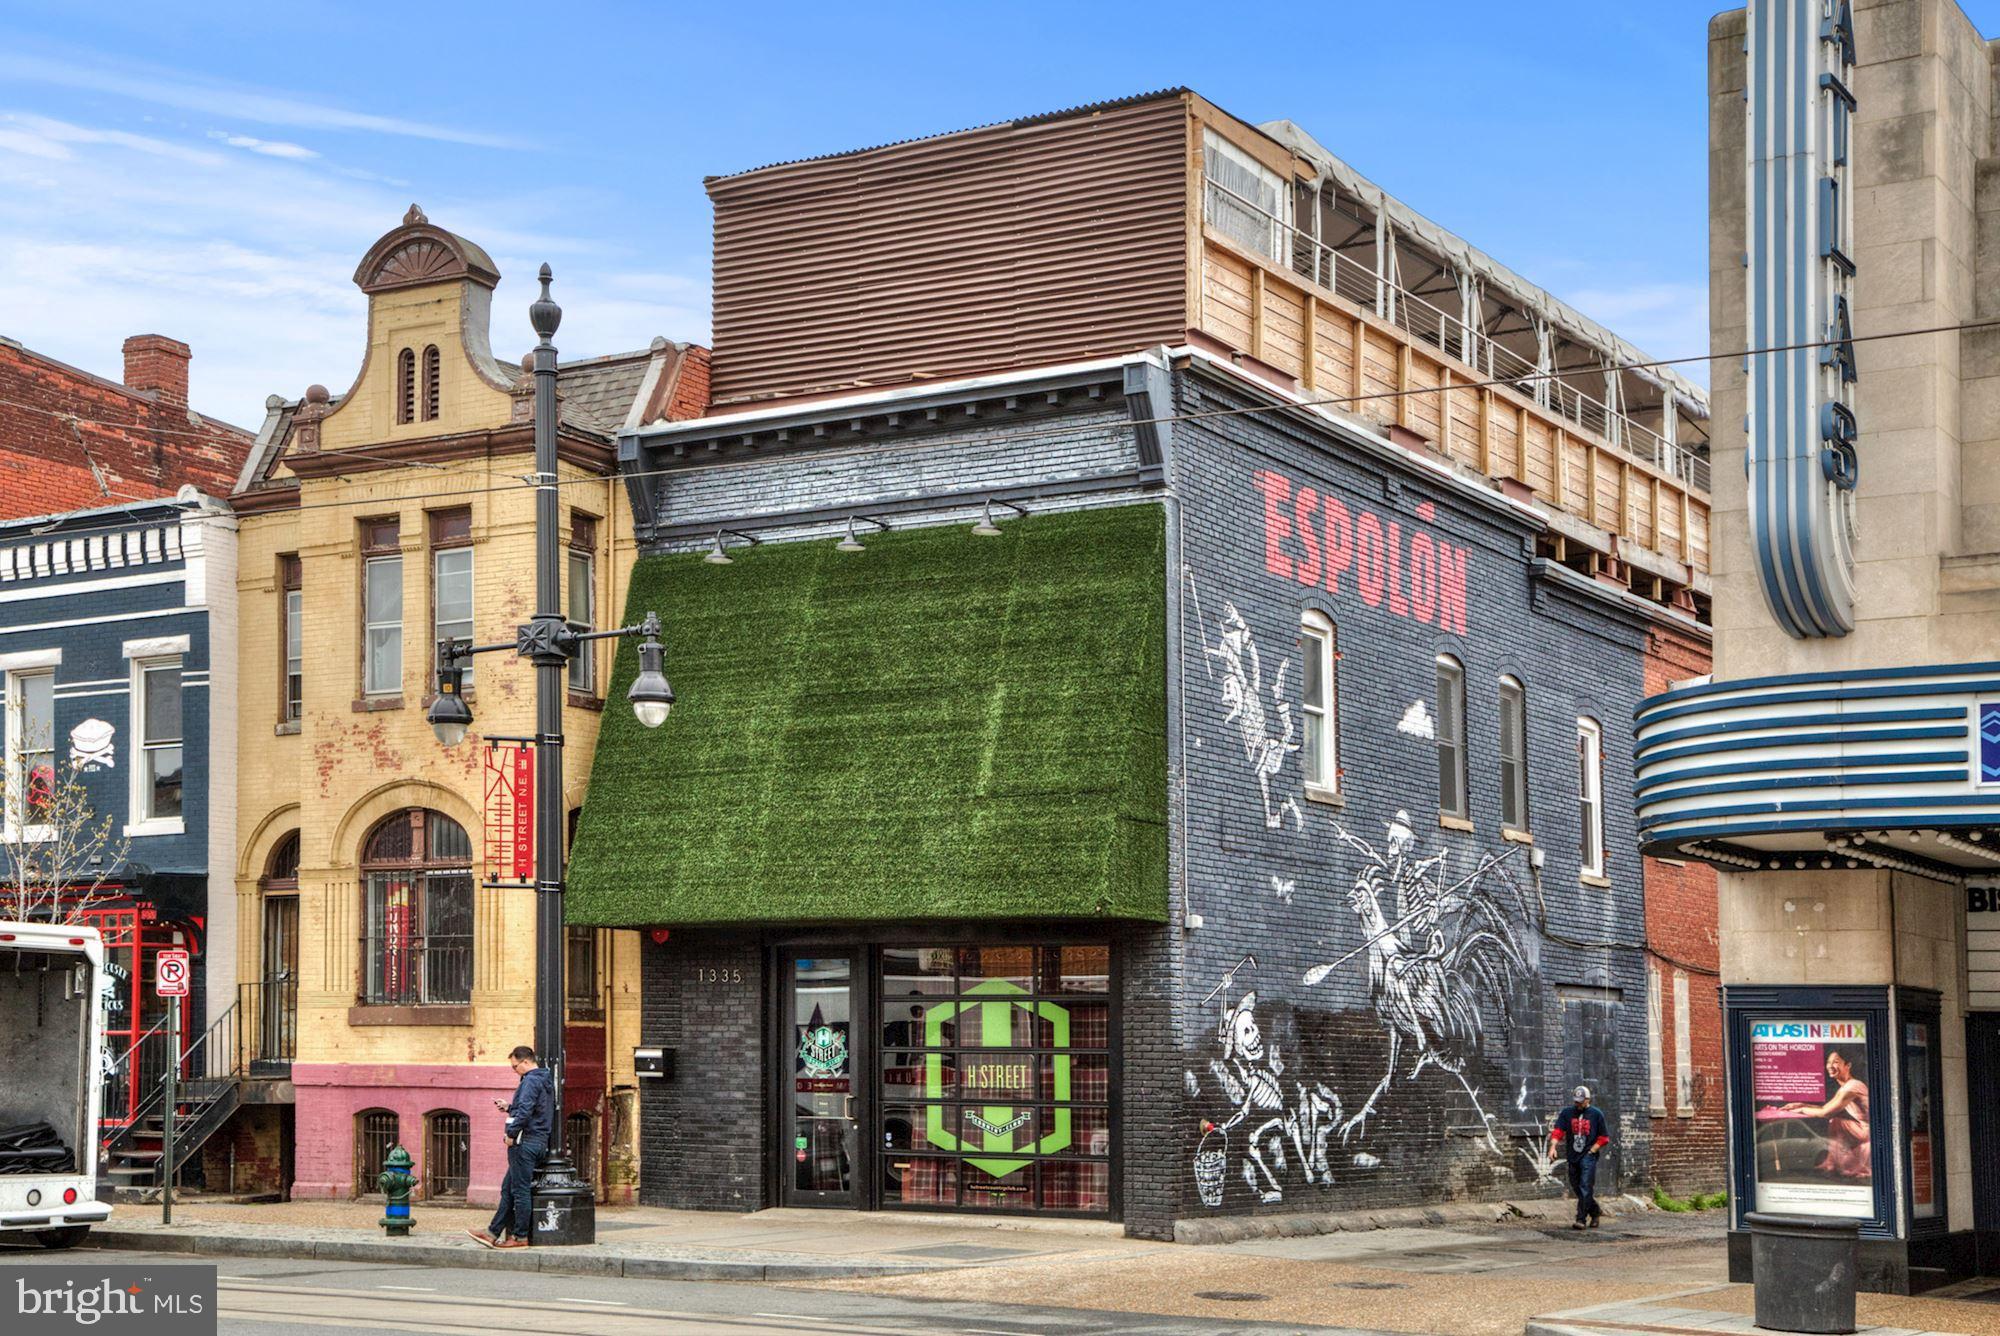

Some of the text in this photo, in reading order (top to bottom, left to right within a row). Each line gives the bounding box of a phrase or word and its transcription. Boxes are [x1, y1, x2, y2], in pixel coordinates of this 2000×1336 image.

[518, 803, 528, 851] STREET
[518, 858, 527, 867] H
[1967, 887, 2000, 912] BI
[699, 968, 741, 983] 1335
[1752, 1023, 1802, 1037] ATLAS
[1804, 1023, 1821, 1037] IN
[1831, 1024, 1865, 1038] MIX
[810, 1044, 836, 1062] STREET
[967, 1064, 1027, 1089] H STREET
